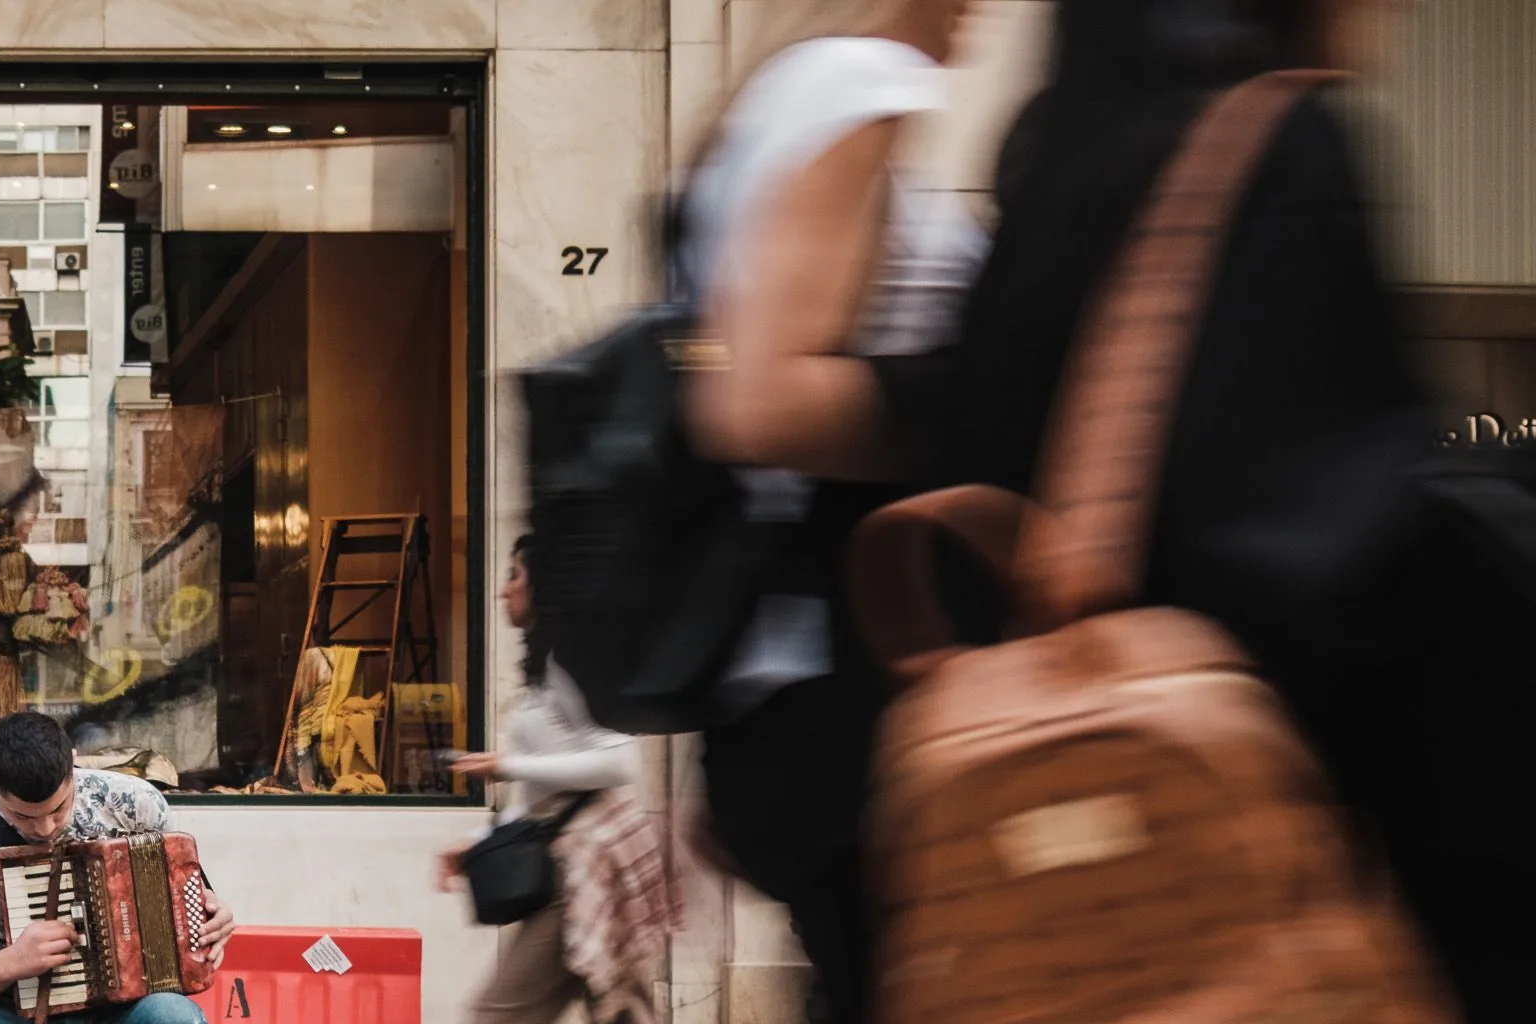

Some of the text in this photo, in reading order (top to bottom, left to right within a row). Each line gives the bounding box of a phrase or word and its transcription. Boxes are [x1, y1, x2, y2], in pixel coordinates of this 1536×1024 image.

[561, 246, 608, 275] 27
[120, 901, 132, 942] HOHNER
[224, 977, 251, 1019] A
